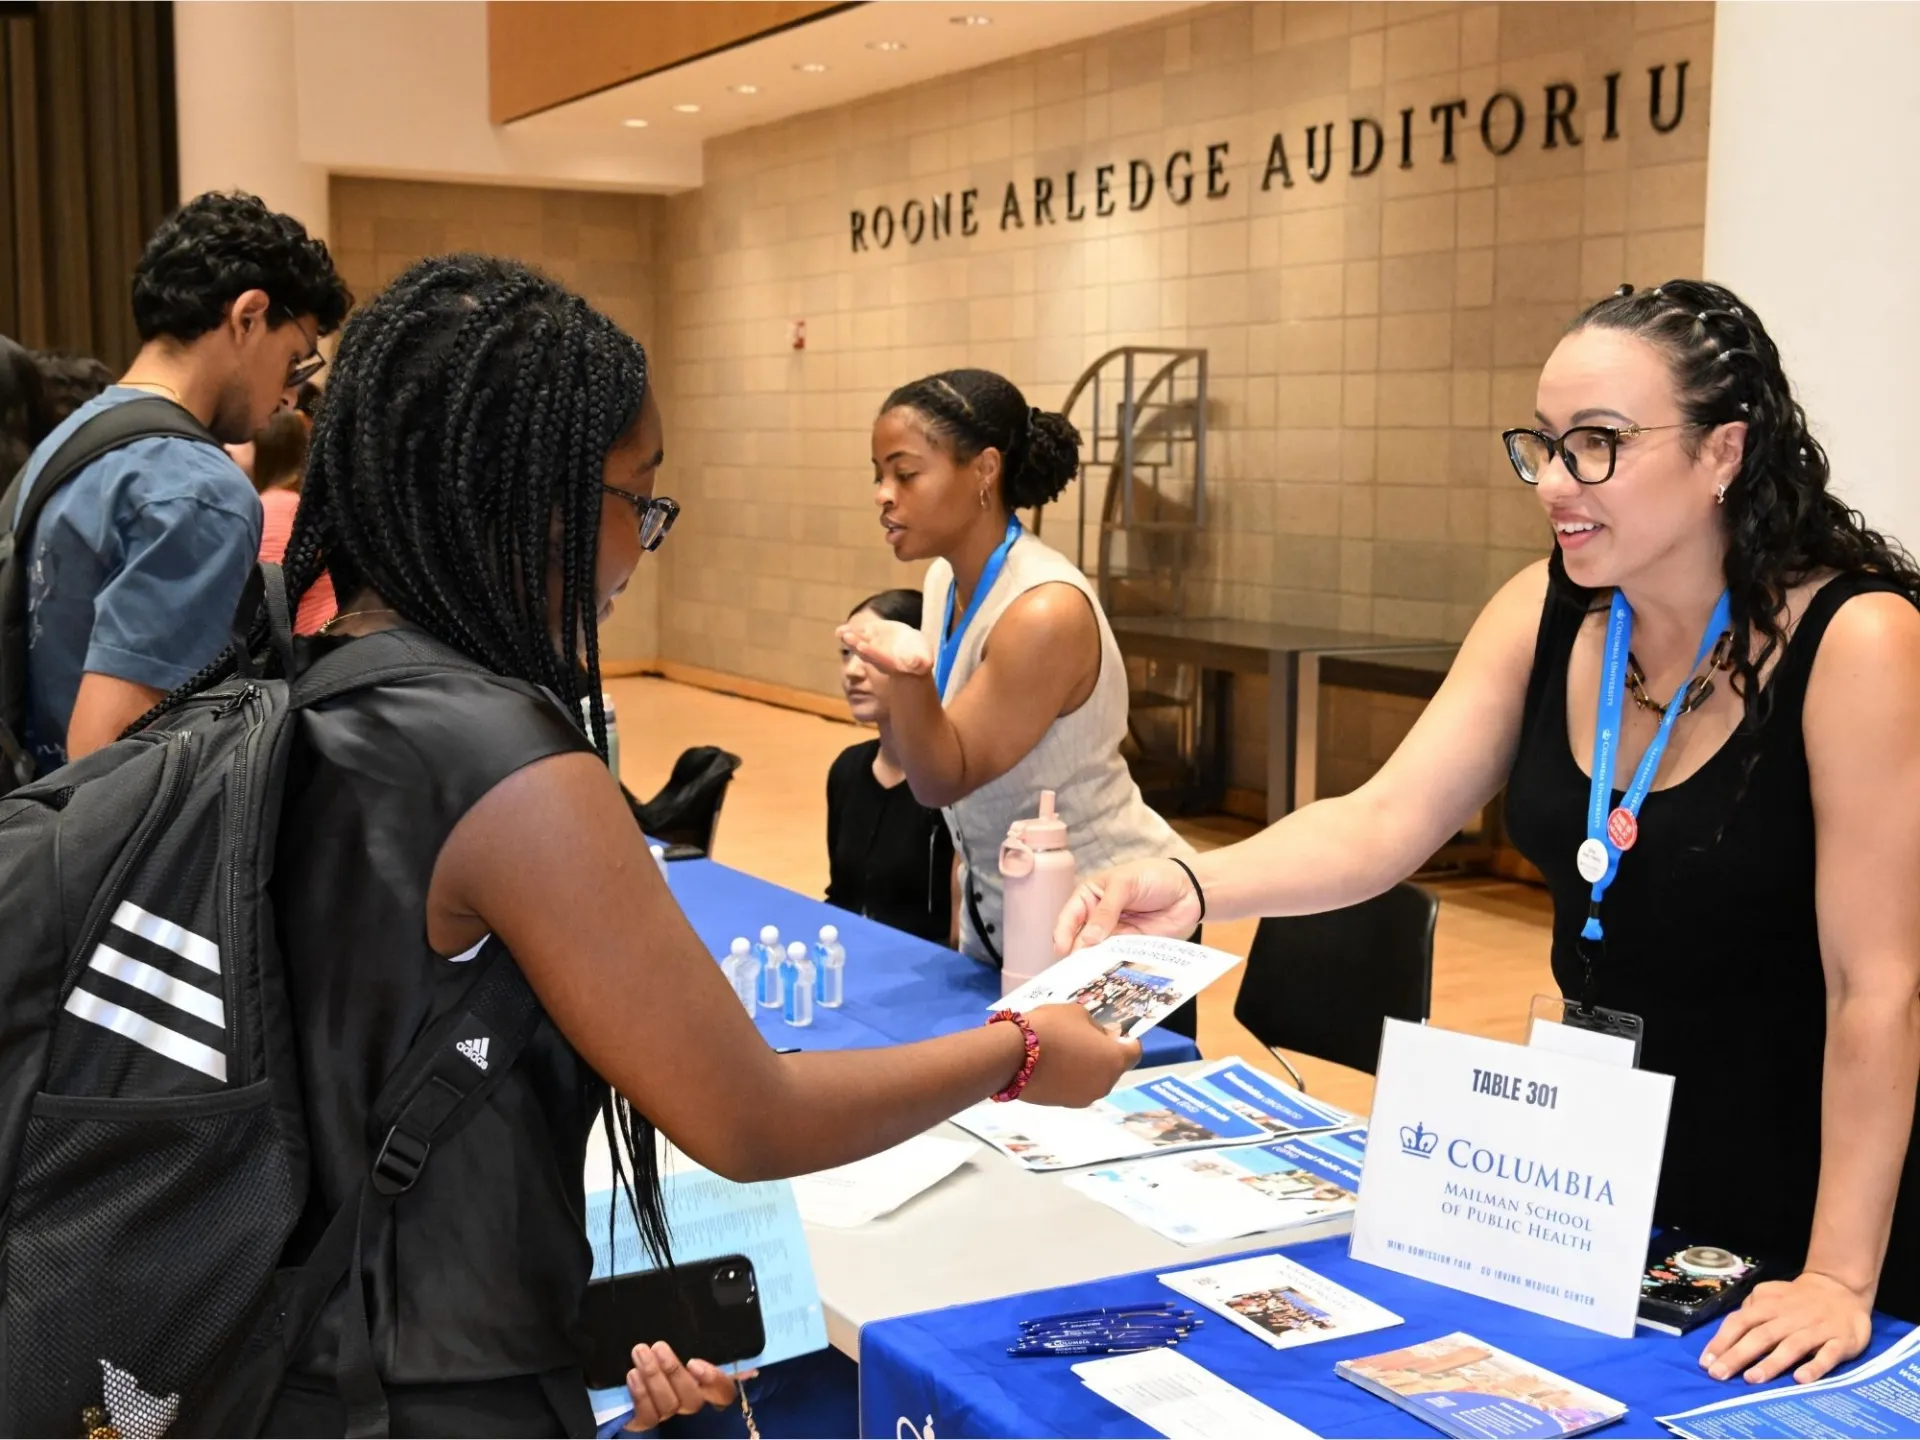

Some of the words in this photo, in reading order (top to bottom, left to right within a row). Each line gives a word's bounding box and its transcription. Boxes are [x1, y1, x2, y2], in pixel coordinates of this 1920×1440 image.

[851, 188, 978, 253] ROONE
[1000, 142, 1231, 231] ARLEDGE
[1261, 60, 1690, 191] AUDITORIU
[1472, 1068, 1521, 1101] TABLE
[1525, 1080, 1558, 1109] 301
[1447, 1138, 1615, 1206] COLUMBIA
[1441, 1201, 1461, 1216] OF
[1467, 1206, 1523, 1234] PUBLIC
[1528, 1222, 1592, 1252] HEALTH
[1444, 1181, 1520, 1212] MAILMAN
[1525, 1201, 1593, 1232] SCHOOL
[1387, 1239, 1405, 1251] MINI
[1453, 1258, 1472, 1271] FAIR
[1524, 1278, 1560, 1297] MEDICAL
[1564, 1290, 1595, 1306] CENTER
